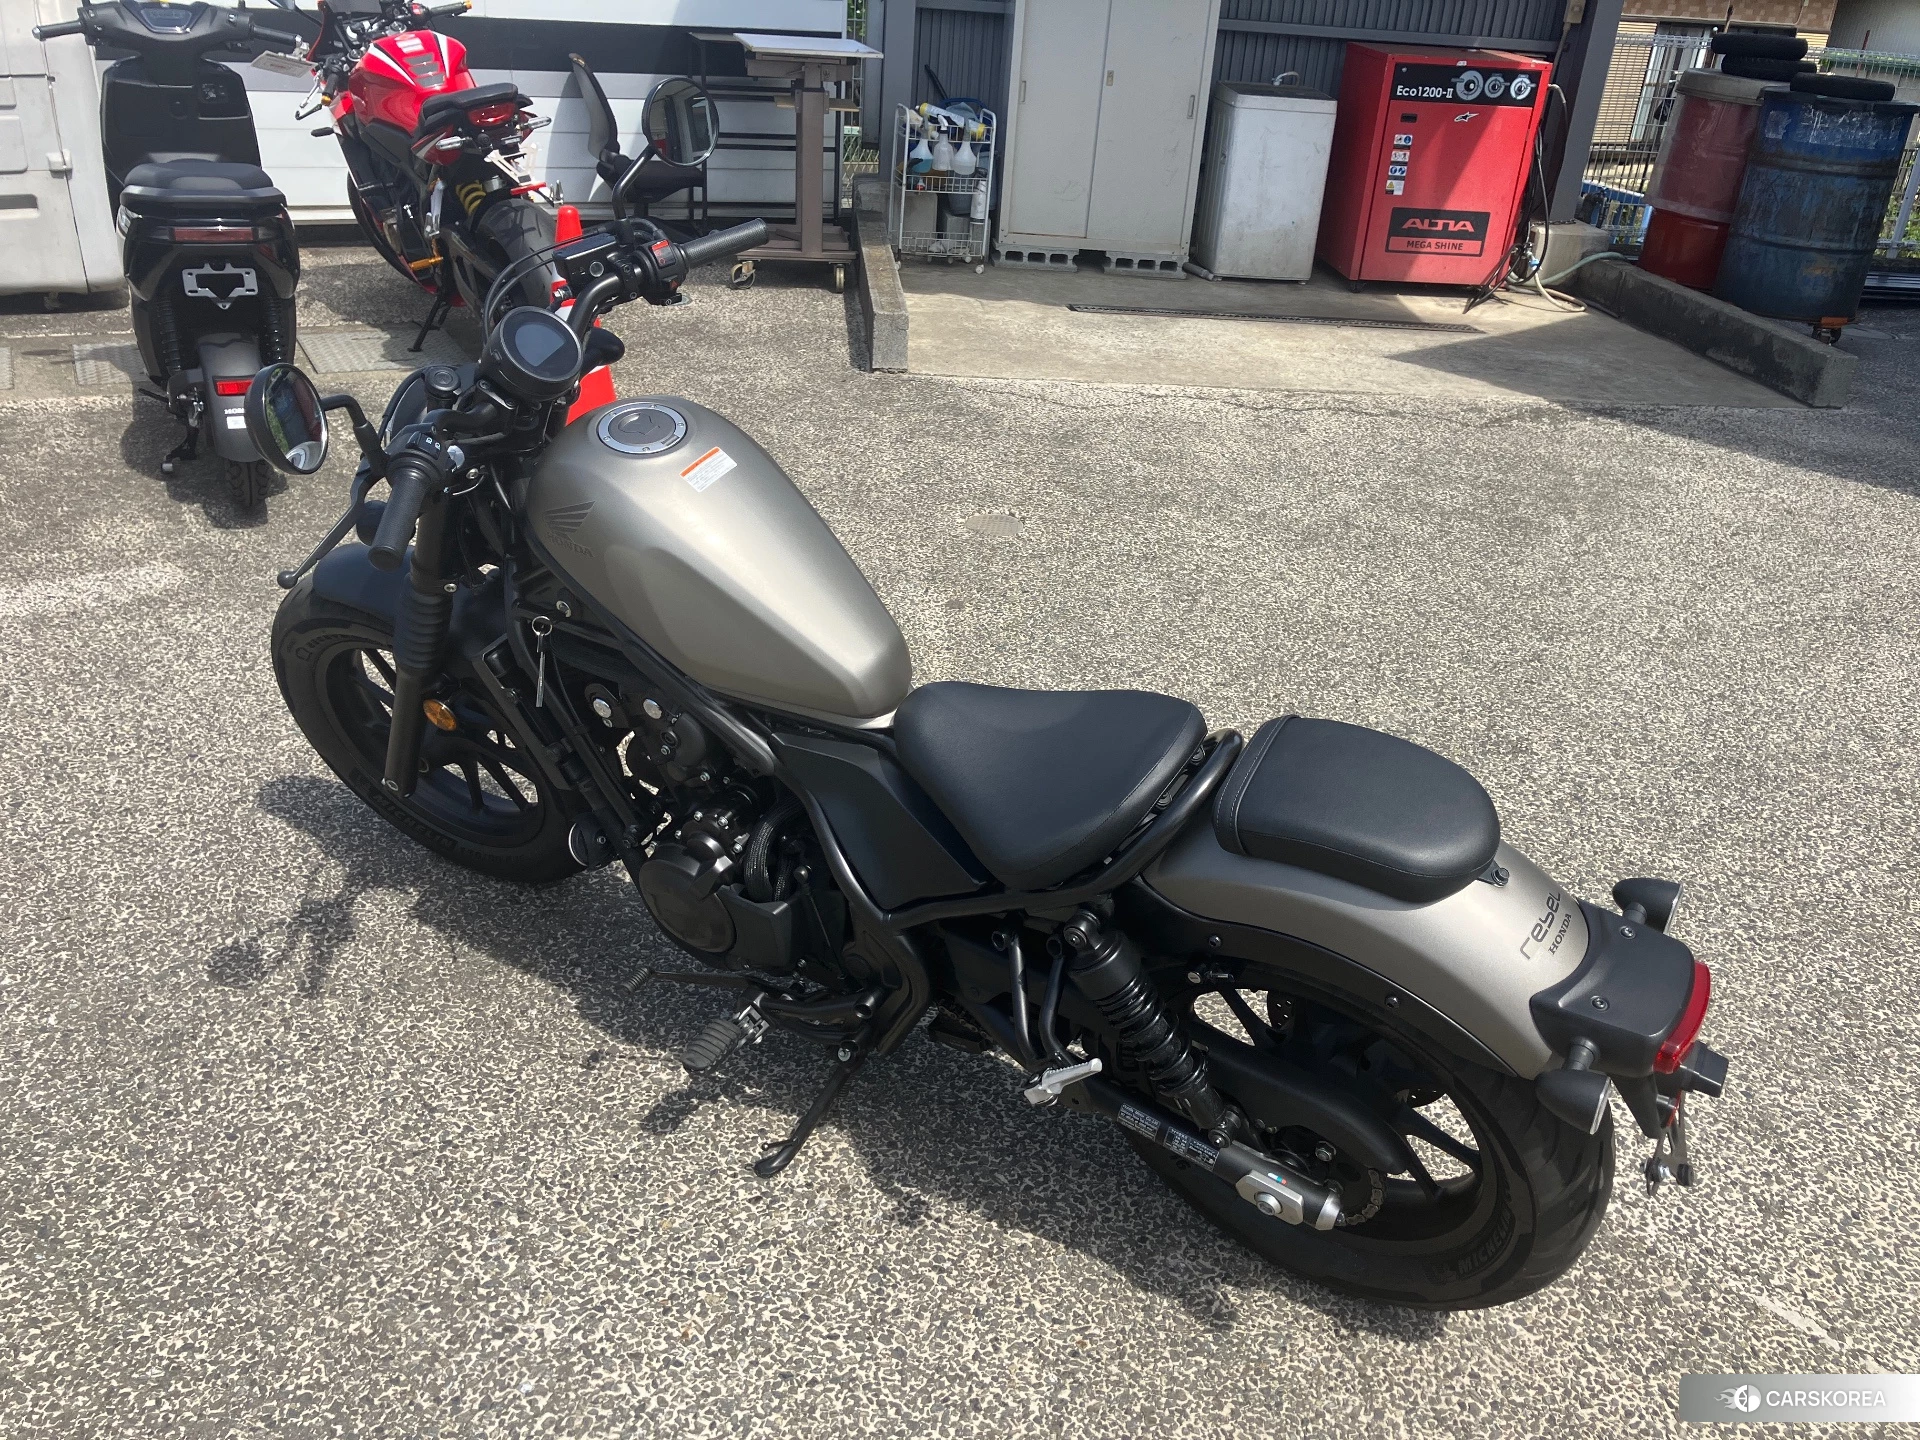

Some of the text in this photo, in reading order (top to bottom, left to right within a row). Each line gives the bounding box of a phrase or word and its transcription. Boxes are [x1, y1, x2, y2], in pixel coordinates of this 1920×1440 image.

[1401, 218, 1475, 233] ALTIA
[1406, 240, 1464, 251] MEGA SHINE
[224, 407, 245, 415] HON
[1519, 892, 1561, 960] rebel
[1548, 913, 1572, 955] HONDA
